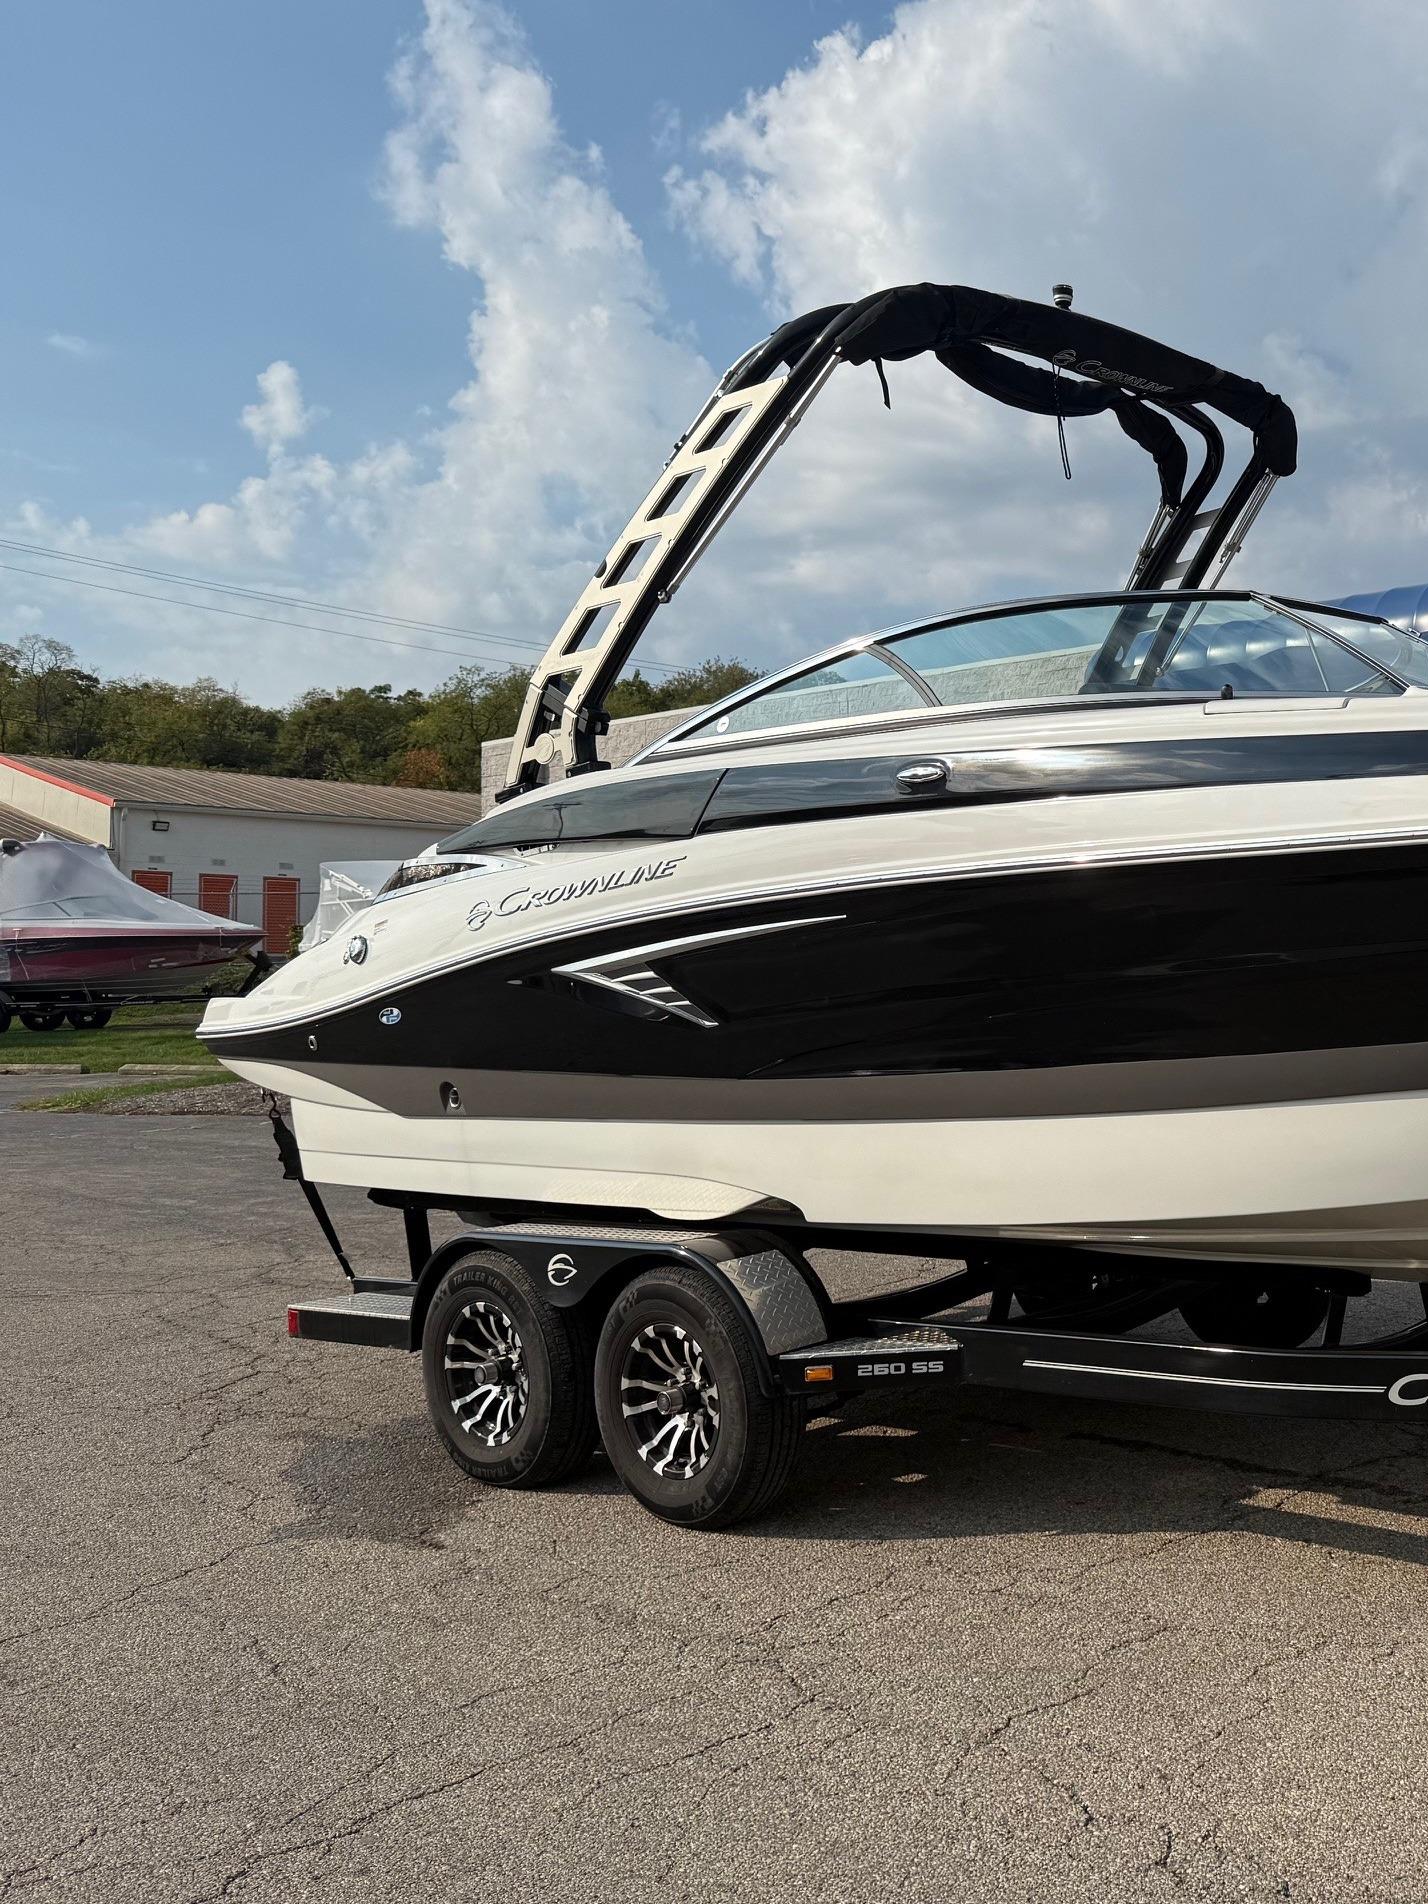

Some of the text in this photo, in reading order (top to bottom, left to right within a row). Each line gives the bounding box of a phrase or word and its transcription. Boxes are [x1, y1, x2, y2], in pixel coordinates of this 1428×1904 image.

[494, 855, 688, 917] CROWNLINE
[453, 1271, 486, 1286] TRAILER
[857, 1361, 944, 1377] 260 SS
